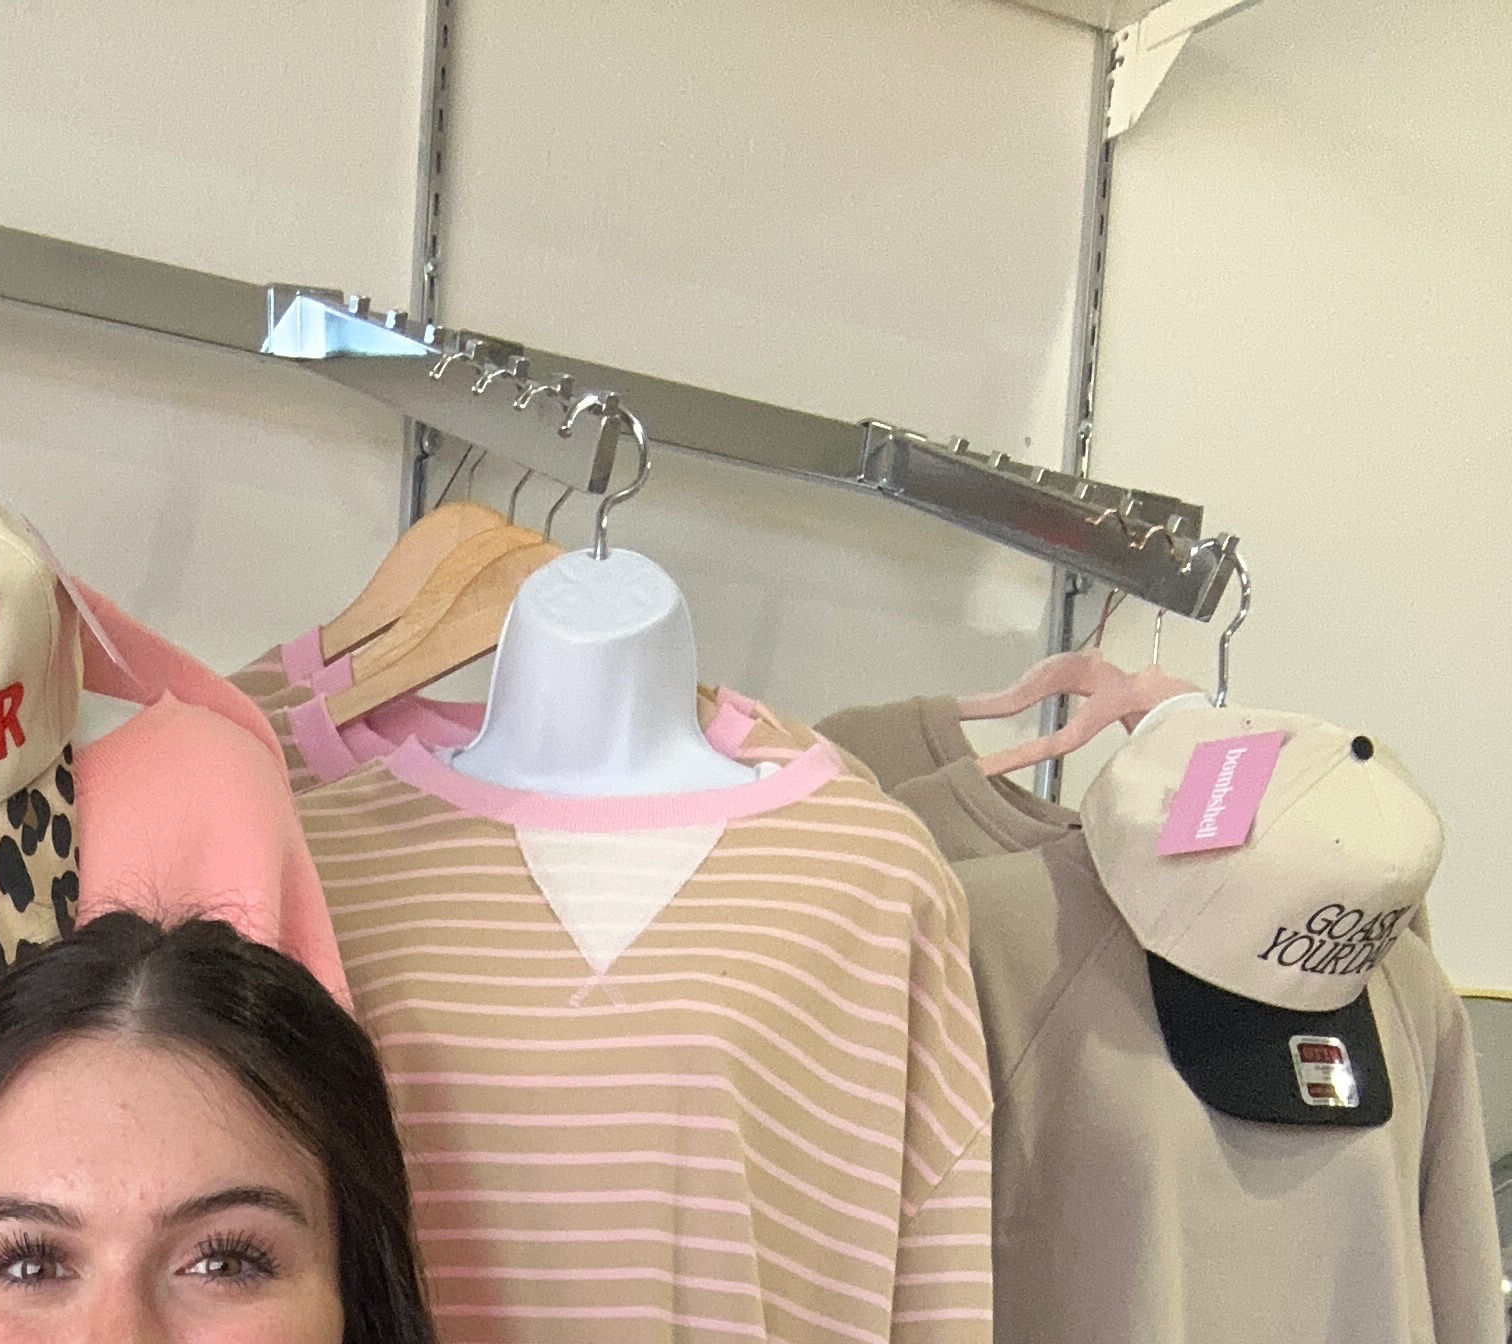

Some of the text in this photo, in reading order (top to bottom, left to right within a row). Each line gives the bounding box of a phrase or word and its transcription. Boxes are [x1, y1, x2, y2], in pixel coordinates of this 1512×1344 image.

[1195, 747, 1248, 839] bombshell
[1306, 903, 1365, 940] GO
[1257, 926, 1356, 975] YOUR
